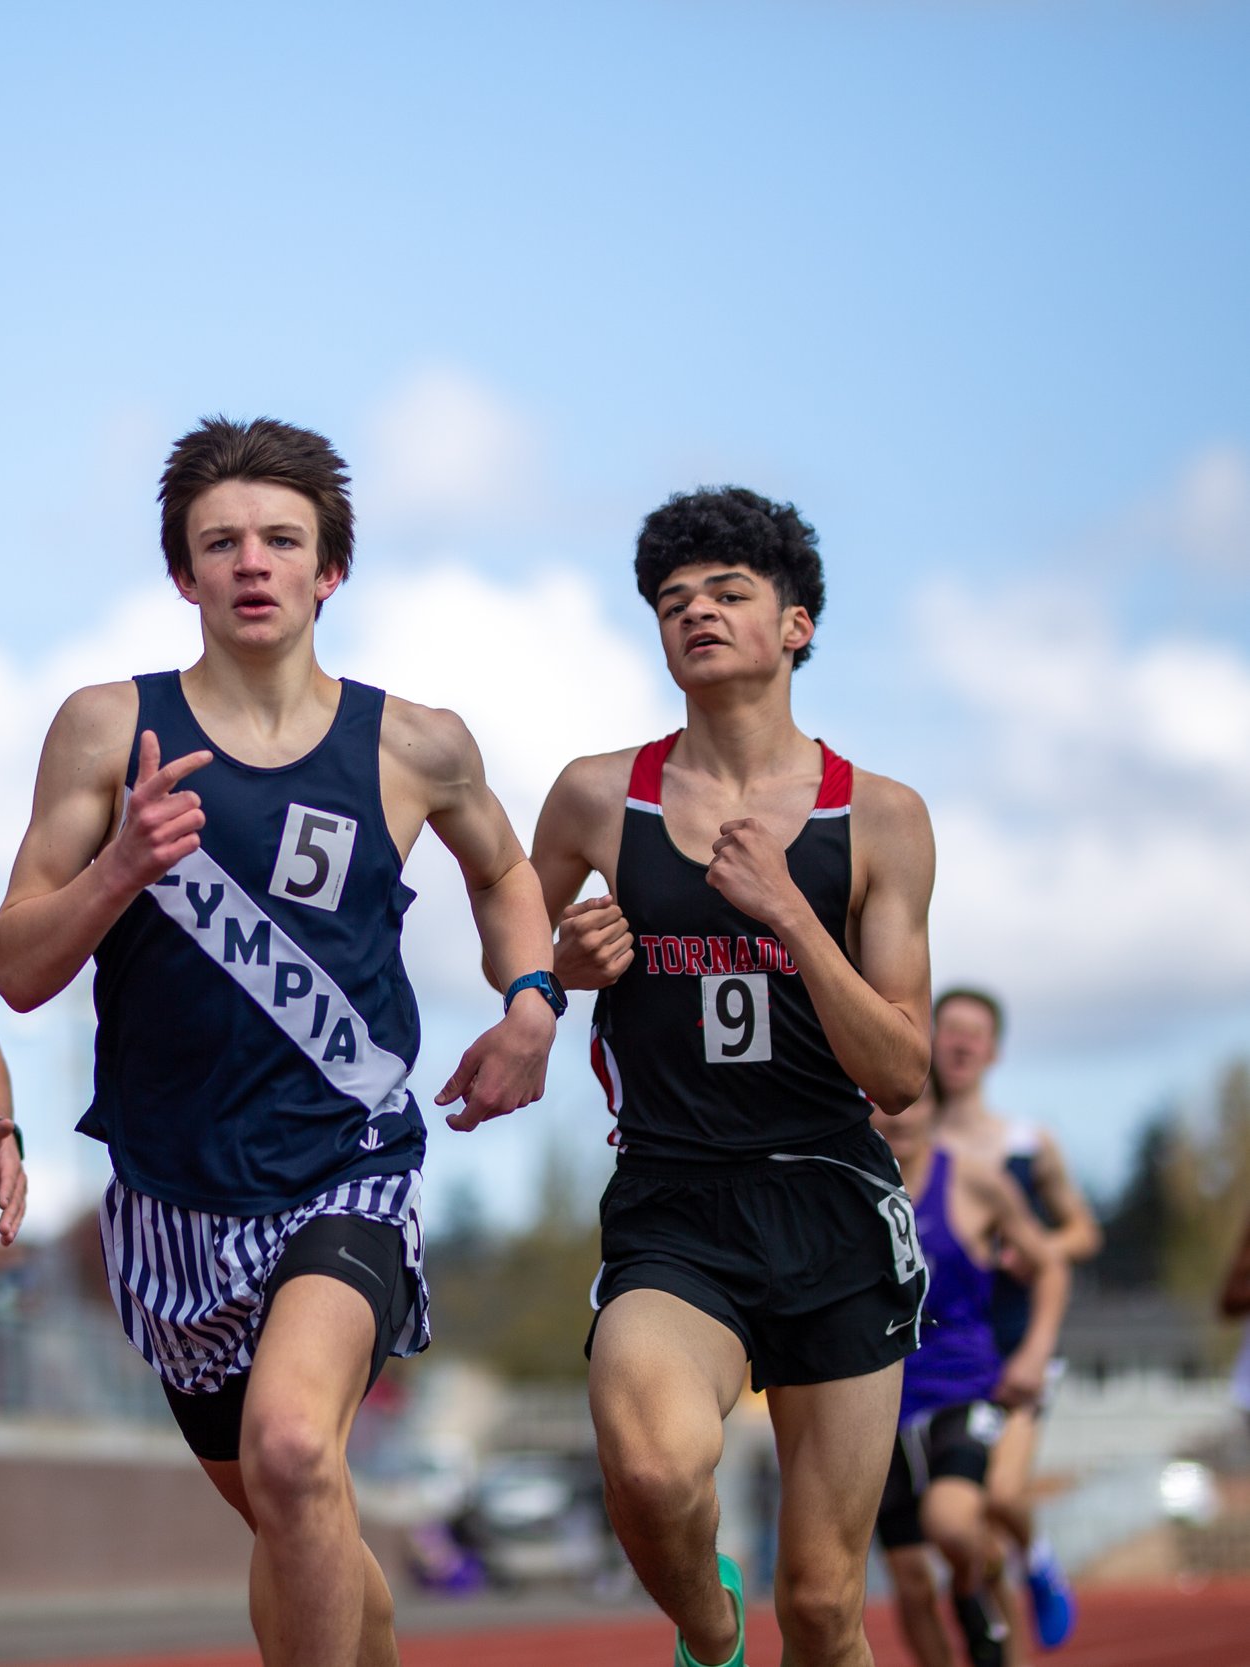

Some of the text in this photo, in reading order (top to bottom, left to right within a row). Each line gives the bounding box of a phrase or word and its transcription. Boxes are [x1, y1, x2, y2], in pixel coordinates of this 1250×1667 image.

[283, 812, 340, 899] 5
[715, 977, 756, 1058] 9
[887, 1196, 917, 1273] 9
